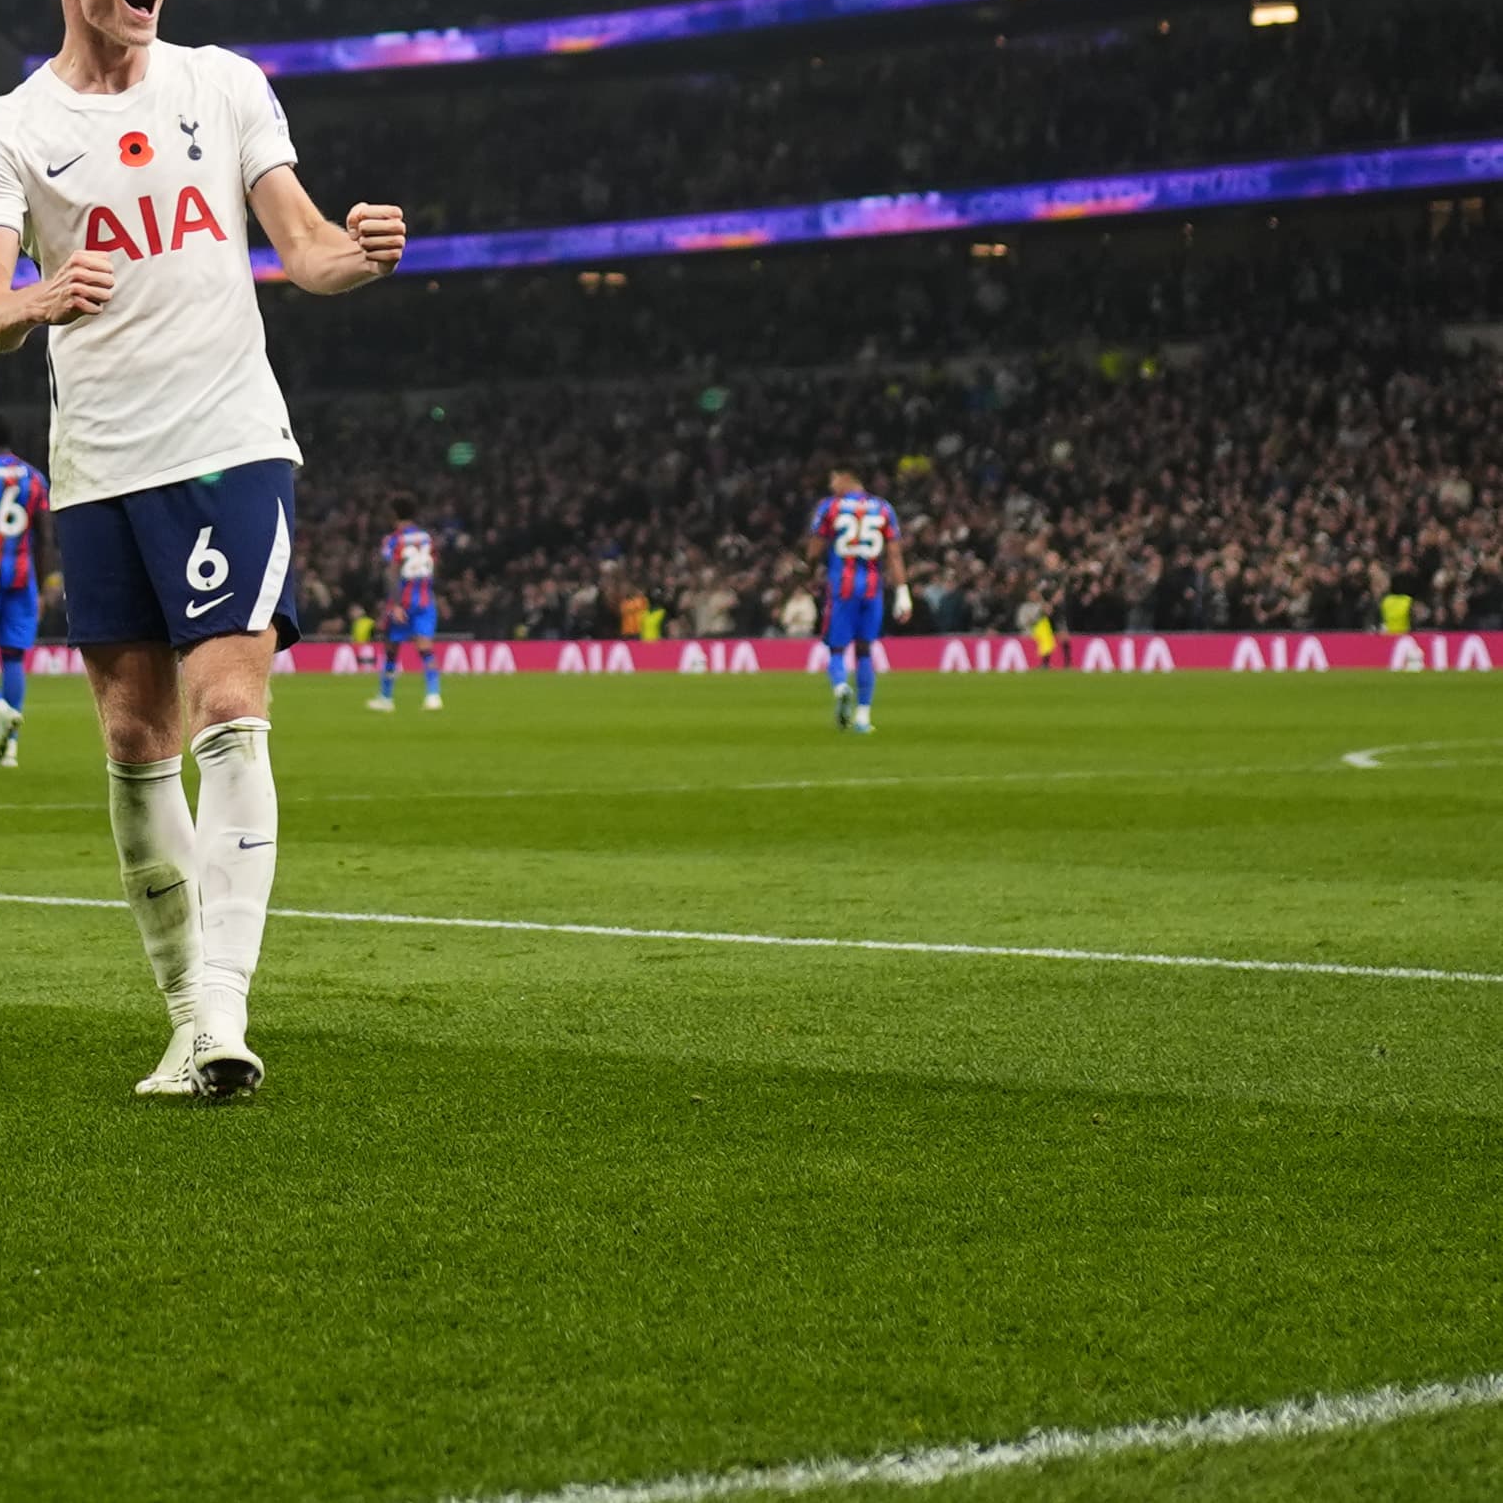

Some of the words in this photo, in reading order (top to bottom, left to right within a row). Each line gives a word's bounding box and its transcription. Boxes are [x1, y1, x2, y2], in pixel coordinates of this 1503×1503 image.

[84, 185, 228, 261] AIA
[832, 513, 886, 560] 25
[185, 526, 231, 591] 6
[441, 642, 518, 674] AIA
[556, 641, 636, 674] AIA
[679, 640, 761, 673] AIA
[939, 639, 1030, 673] AIA
[1082, 637, 1176, 673] AIA
[1232, 636, 1330, 672] AIA
[1389, 635, 1493, 672] AIA
